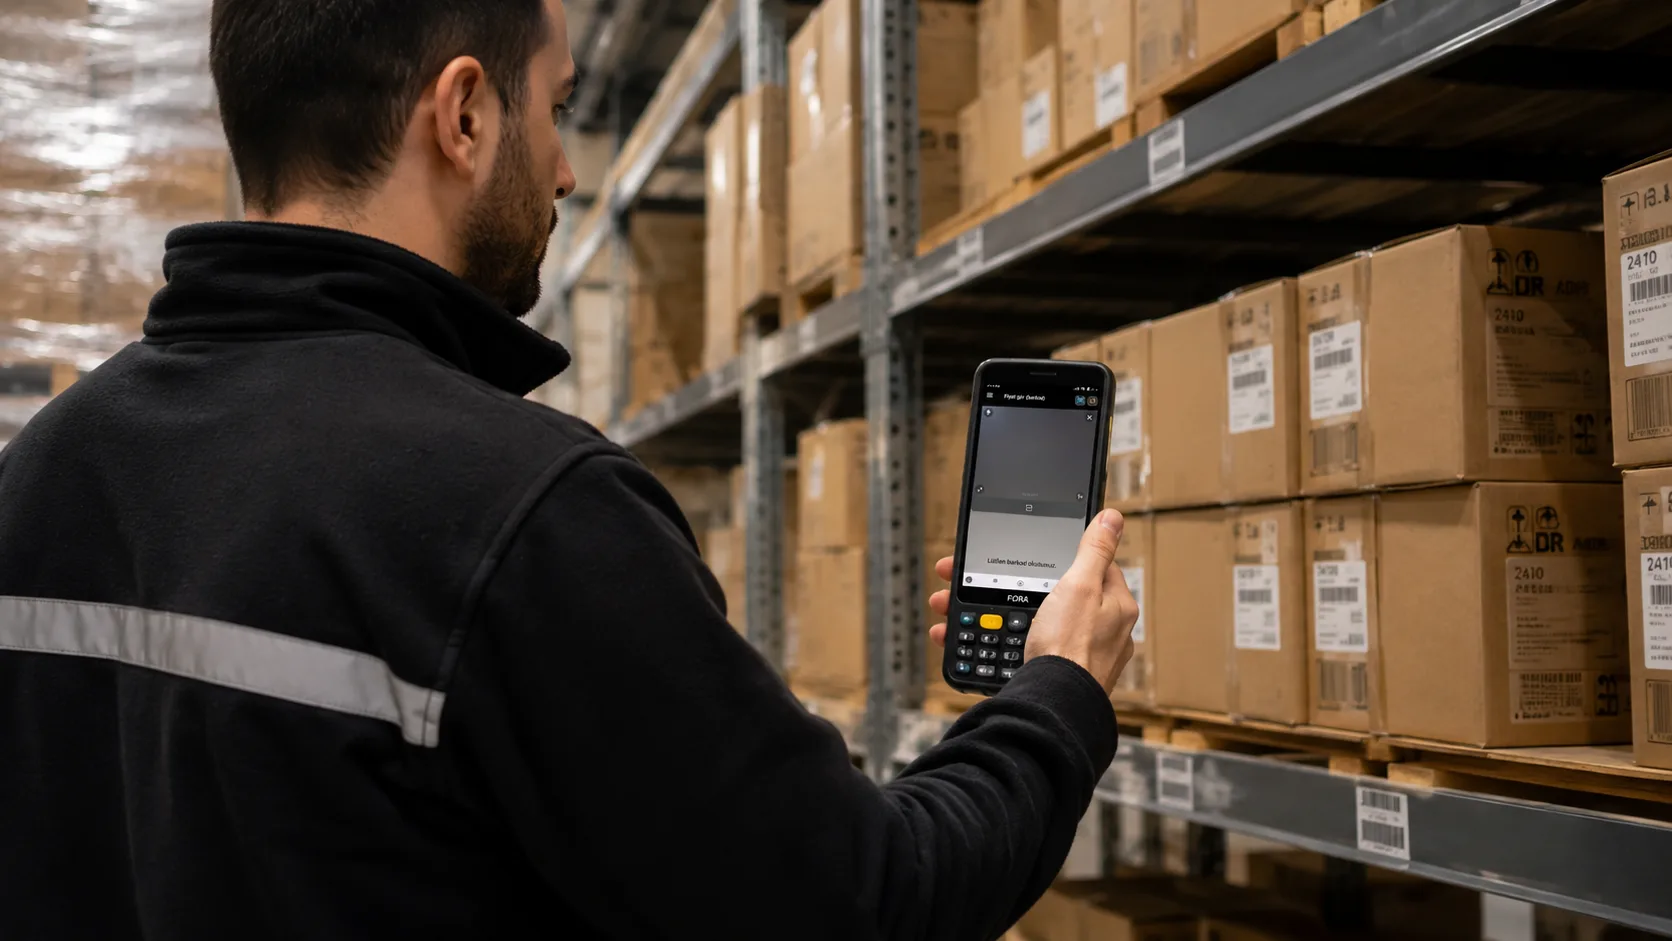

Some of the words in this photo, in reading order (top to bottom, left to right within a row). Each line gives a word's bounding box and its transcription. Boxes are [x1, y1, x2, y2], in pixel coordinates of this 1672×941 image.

[1627, 250, 1657, 270] 2410
[1515, 275, 1544, 296] DR
[1494, 308, 1524, 322] 2410
[1535, 531, 1564, 553] DR
[1514, 566, 1544, 580] 2410
[1007, 594, 1029, 603] FORA
